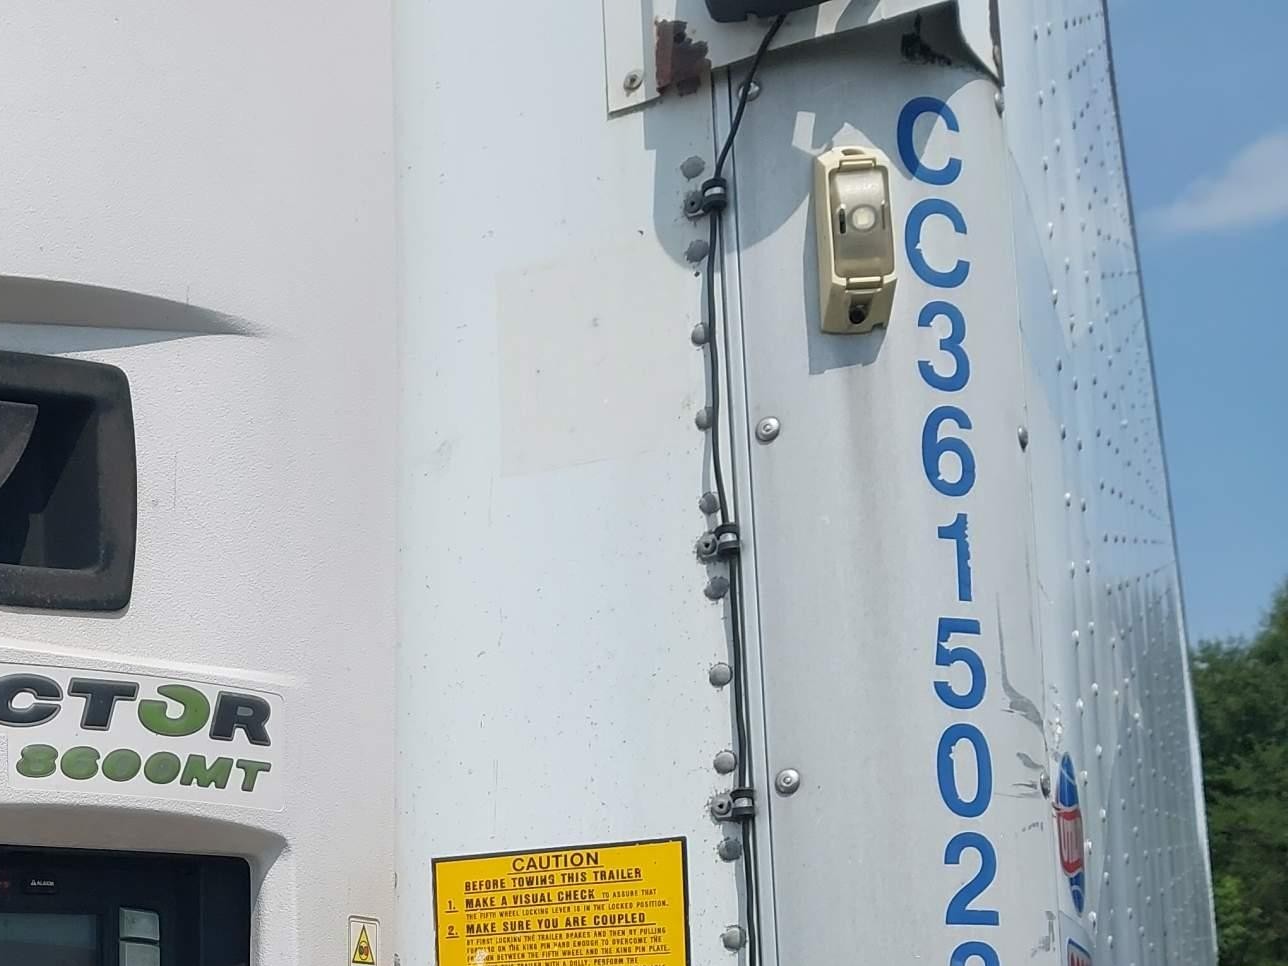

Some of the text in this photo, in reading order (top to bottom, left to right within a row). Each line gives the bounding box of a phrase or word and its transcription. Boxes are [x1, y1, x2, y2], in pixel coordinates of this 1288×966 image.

[15, 744, 272, 793] 8600MT
[512, 852, 599, 872] CAUTION
[464, 868, 642, 891] BEFORE TOWING THIS TRAILER
[447, 900, 456, 910] 1.
[465, 896, 496, 909] MAKE
[501, 896, 508, 906] A
[513, 892, 552, 905] VISUAL
[557, 889, 595, 902] CHECK
[641, 888, 656, 896] THAT
[480, 911, 496, 919] FIFTH
[499, 910, 519, 918] WHEEL
[522, 908, 549, 916] LOCKING
[552, 905, 571, 914] LEVER
[593, 903, 605, 911] THE
[608, 902, 633, 910] LOCKED
[447, 912, 645, 935] 2. MAKE SURE YOU ARE COUPLED
[593, 930, 606, 938] AND
[639, 927, 666, 935] PULLING
[497, 953, 525, 961] BETWEEN
[541, 950, 559, 958] FIFTH
[562, 949, 583, 957] WHEEL
[635, 945, 646, 953] PIN
[509, 943, 519, 951] THE
[522, 943, 537, 951] KING
[612, 937, 647, 945] OVERCOME
